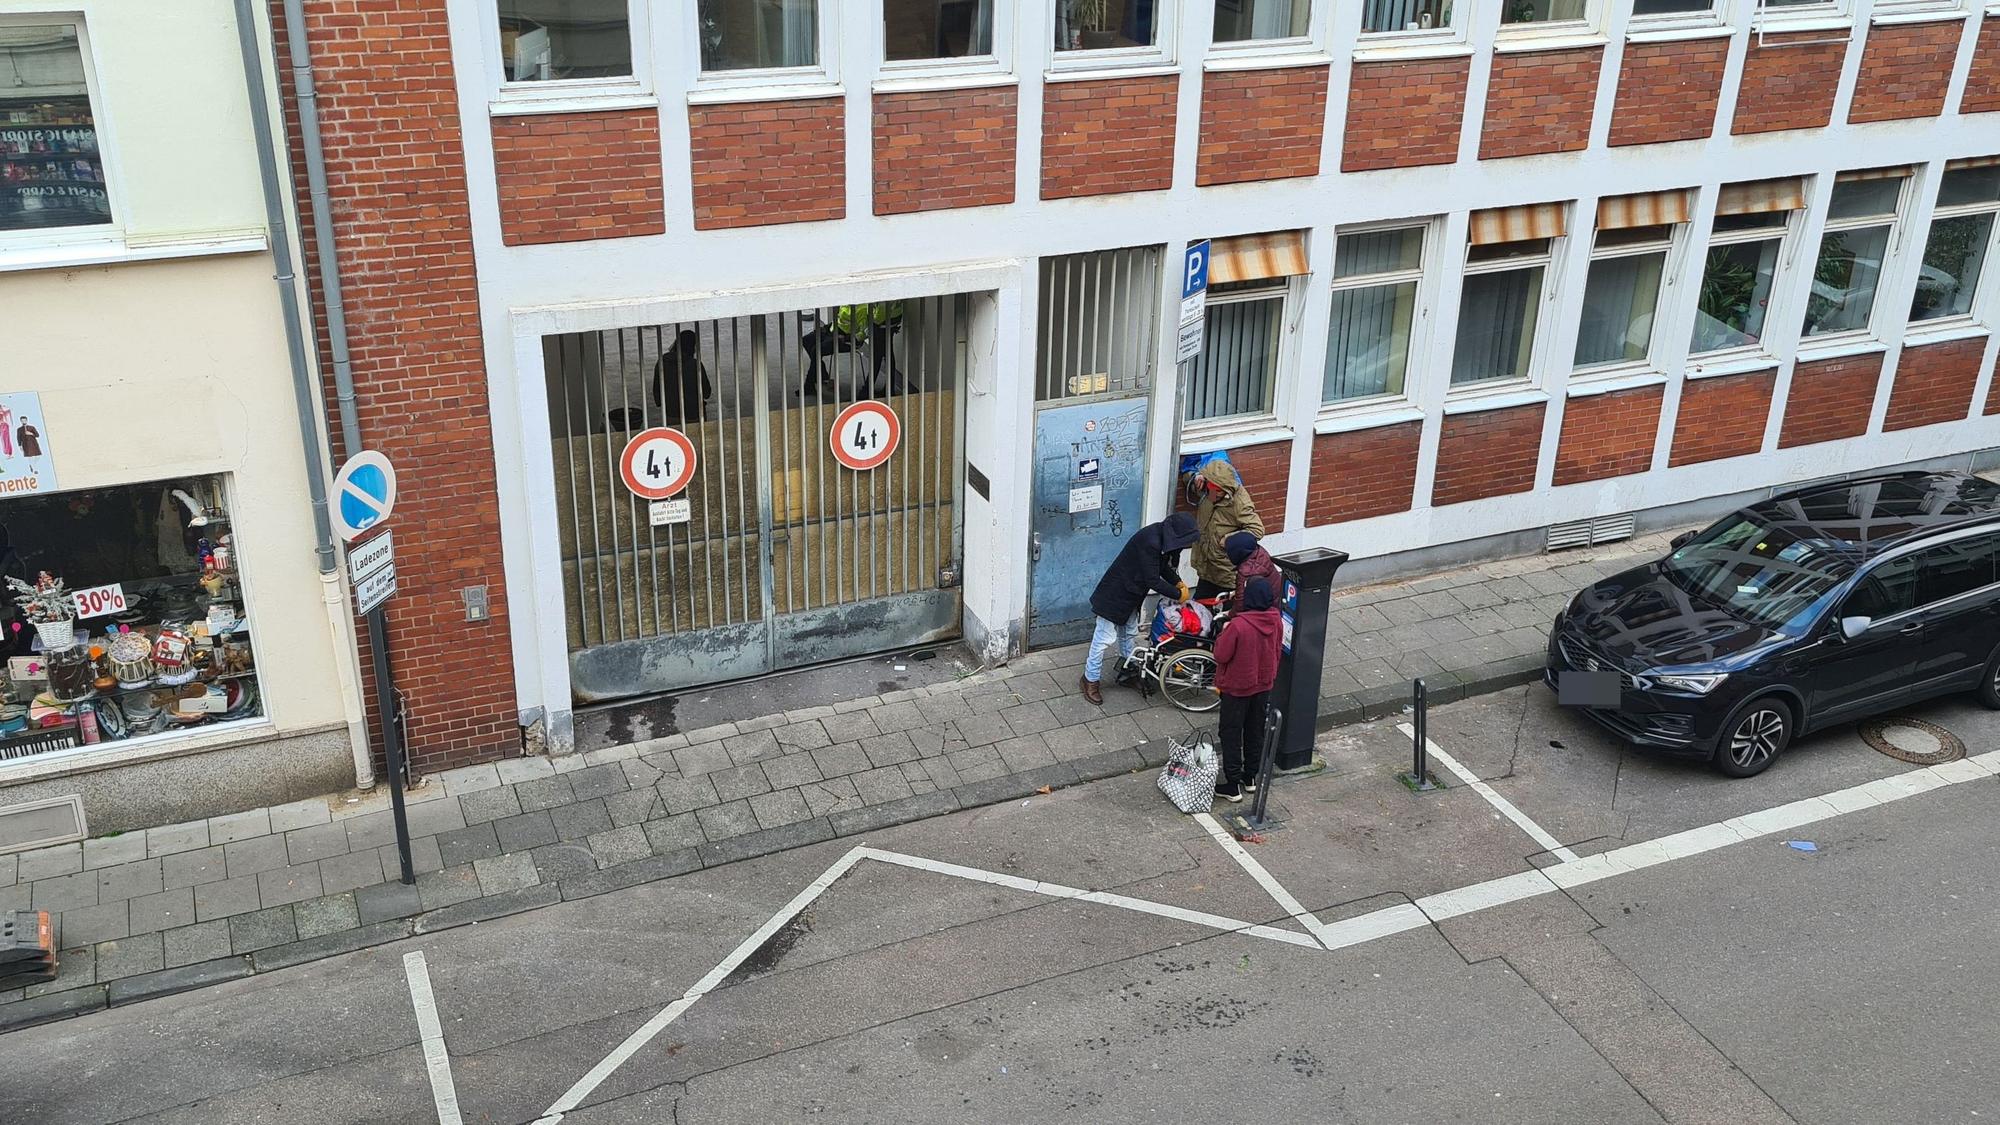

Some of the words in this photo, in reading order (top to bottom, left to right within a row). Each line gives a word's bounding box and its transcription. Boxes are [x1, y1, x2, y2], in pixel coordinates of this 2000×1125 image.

[1187, 251, 1202, 291] P
[354, 545, 389, 571] Ladezone
[360, 581, 394, 608] Seitenstreifen
[366, 582, 375, 593] auf
[376, 574, 387, 587] dem
[76, 587, 123, 615] 30%
